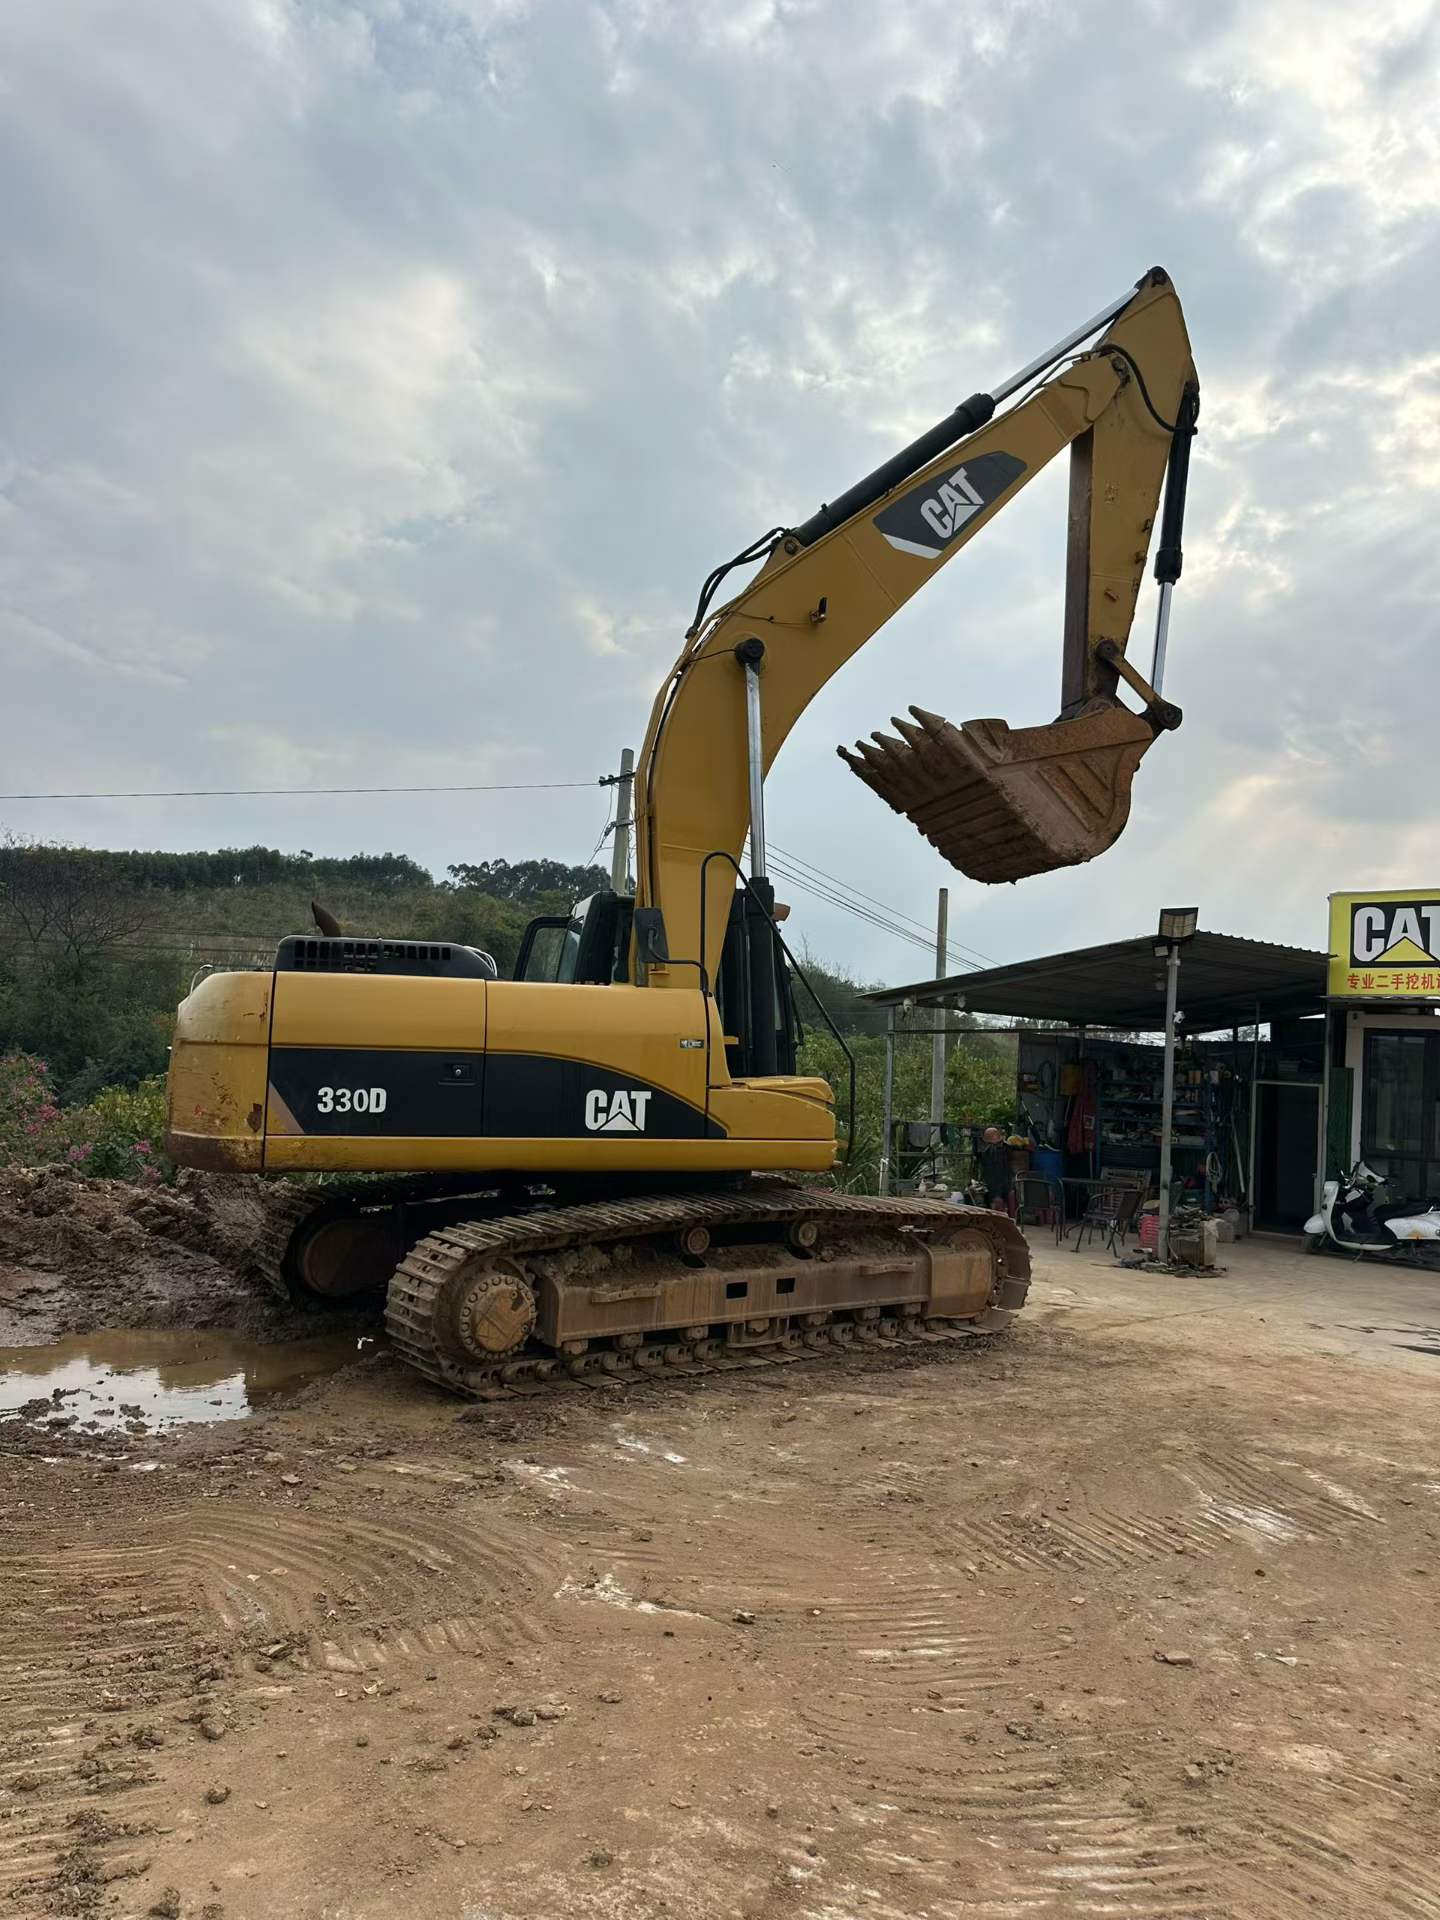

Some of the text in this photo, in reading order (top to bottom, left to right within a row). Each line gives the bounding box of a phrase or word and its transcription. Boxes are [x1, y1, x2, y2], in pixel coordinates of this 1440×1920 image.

[920, 467, 985, 539] CAT
[1353, 905, 1440, 962] CAT
[317, 1087, 387, 1113] 330D
[585, 1089, 652, 1131] CAT
